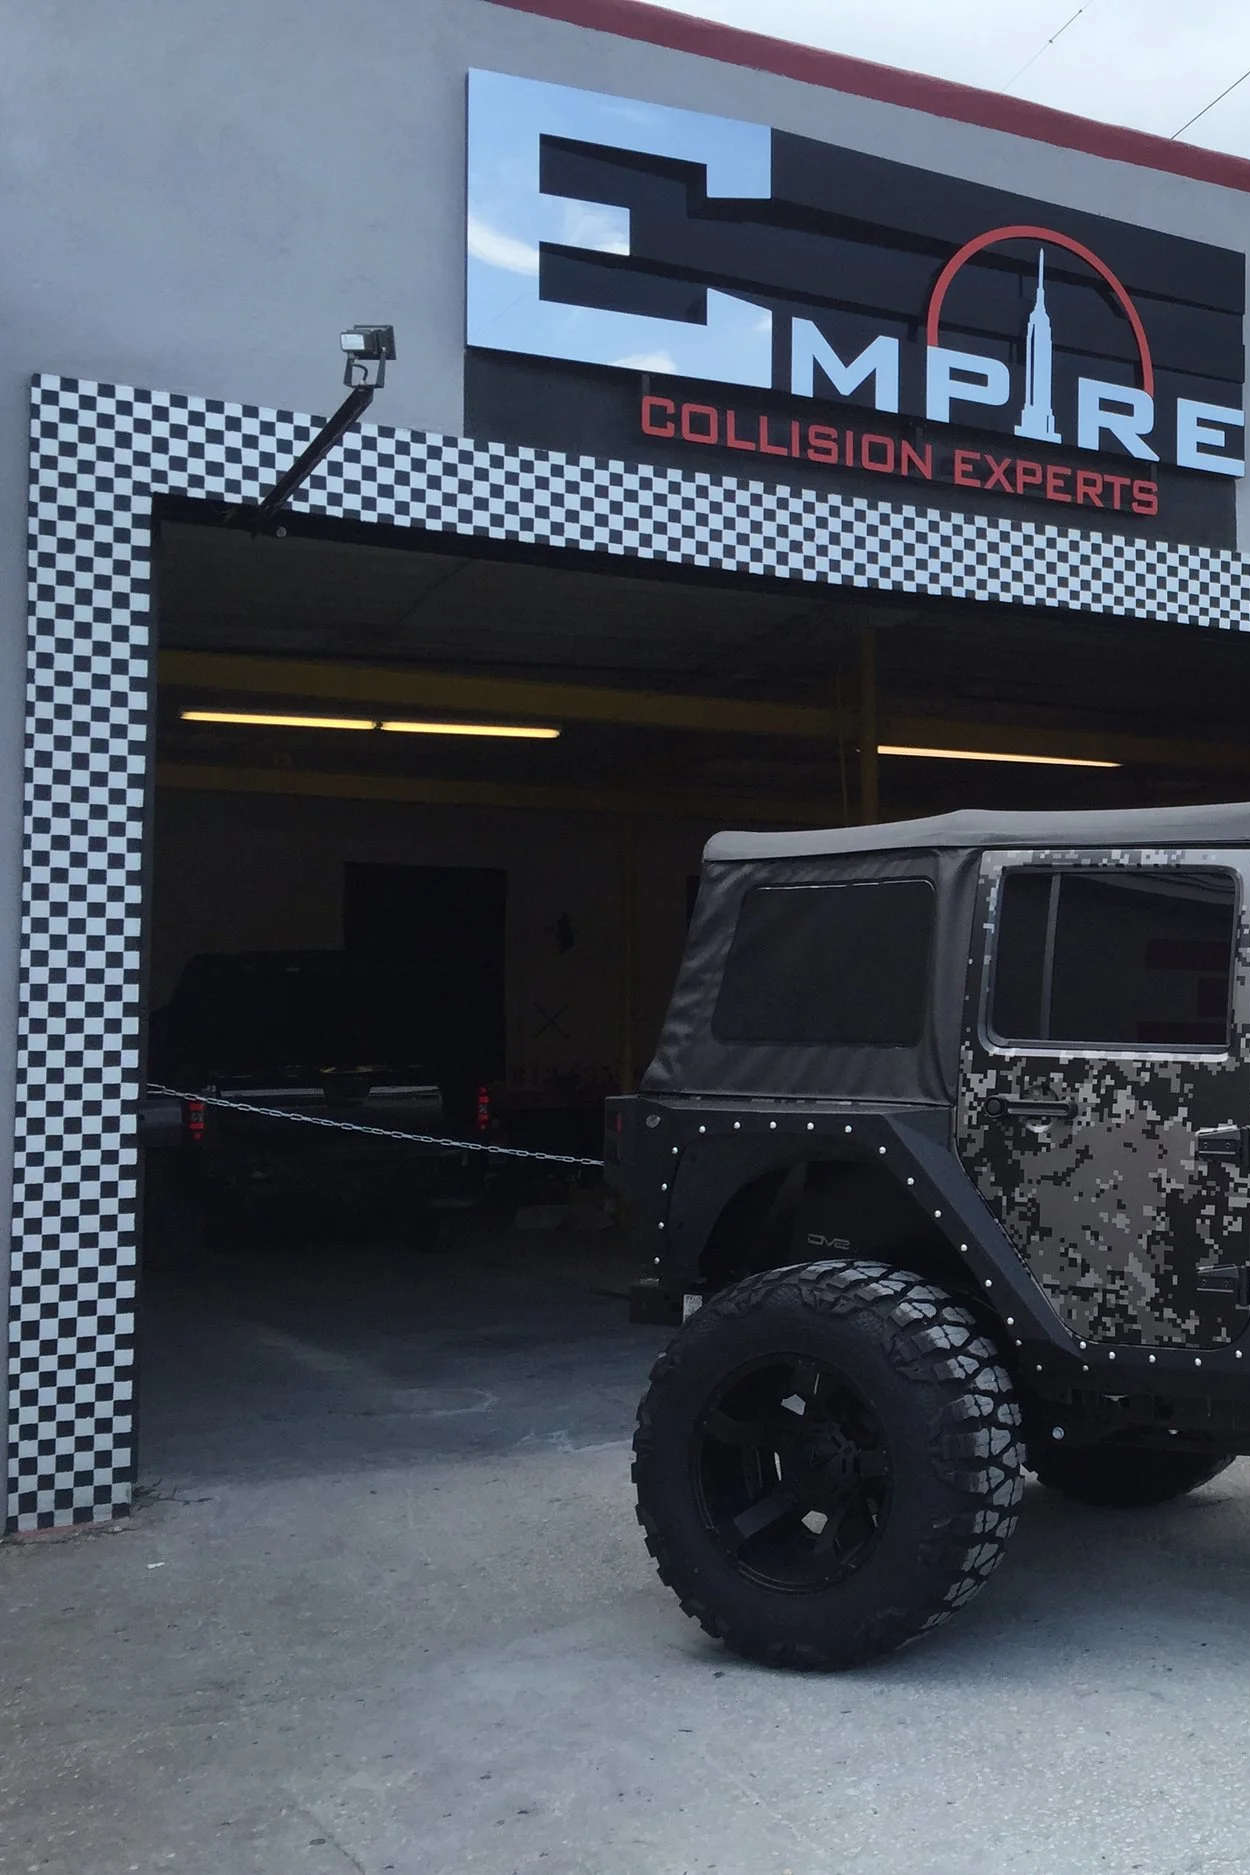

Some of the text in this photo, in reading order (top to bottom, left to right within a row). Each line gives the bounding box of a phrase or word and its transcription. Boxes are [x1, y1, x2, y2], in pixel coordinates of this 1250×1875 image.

[467, 67, 1245, 477] EMPIRE
[641, 396, 1159, 516] COLLISION EXPERTS
